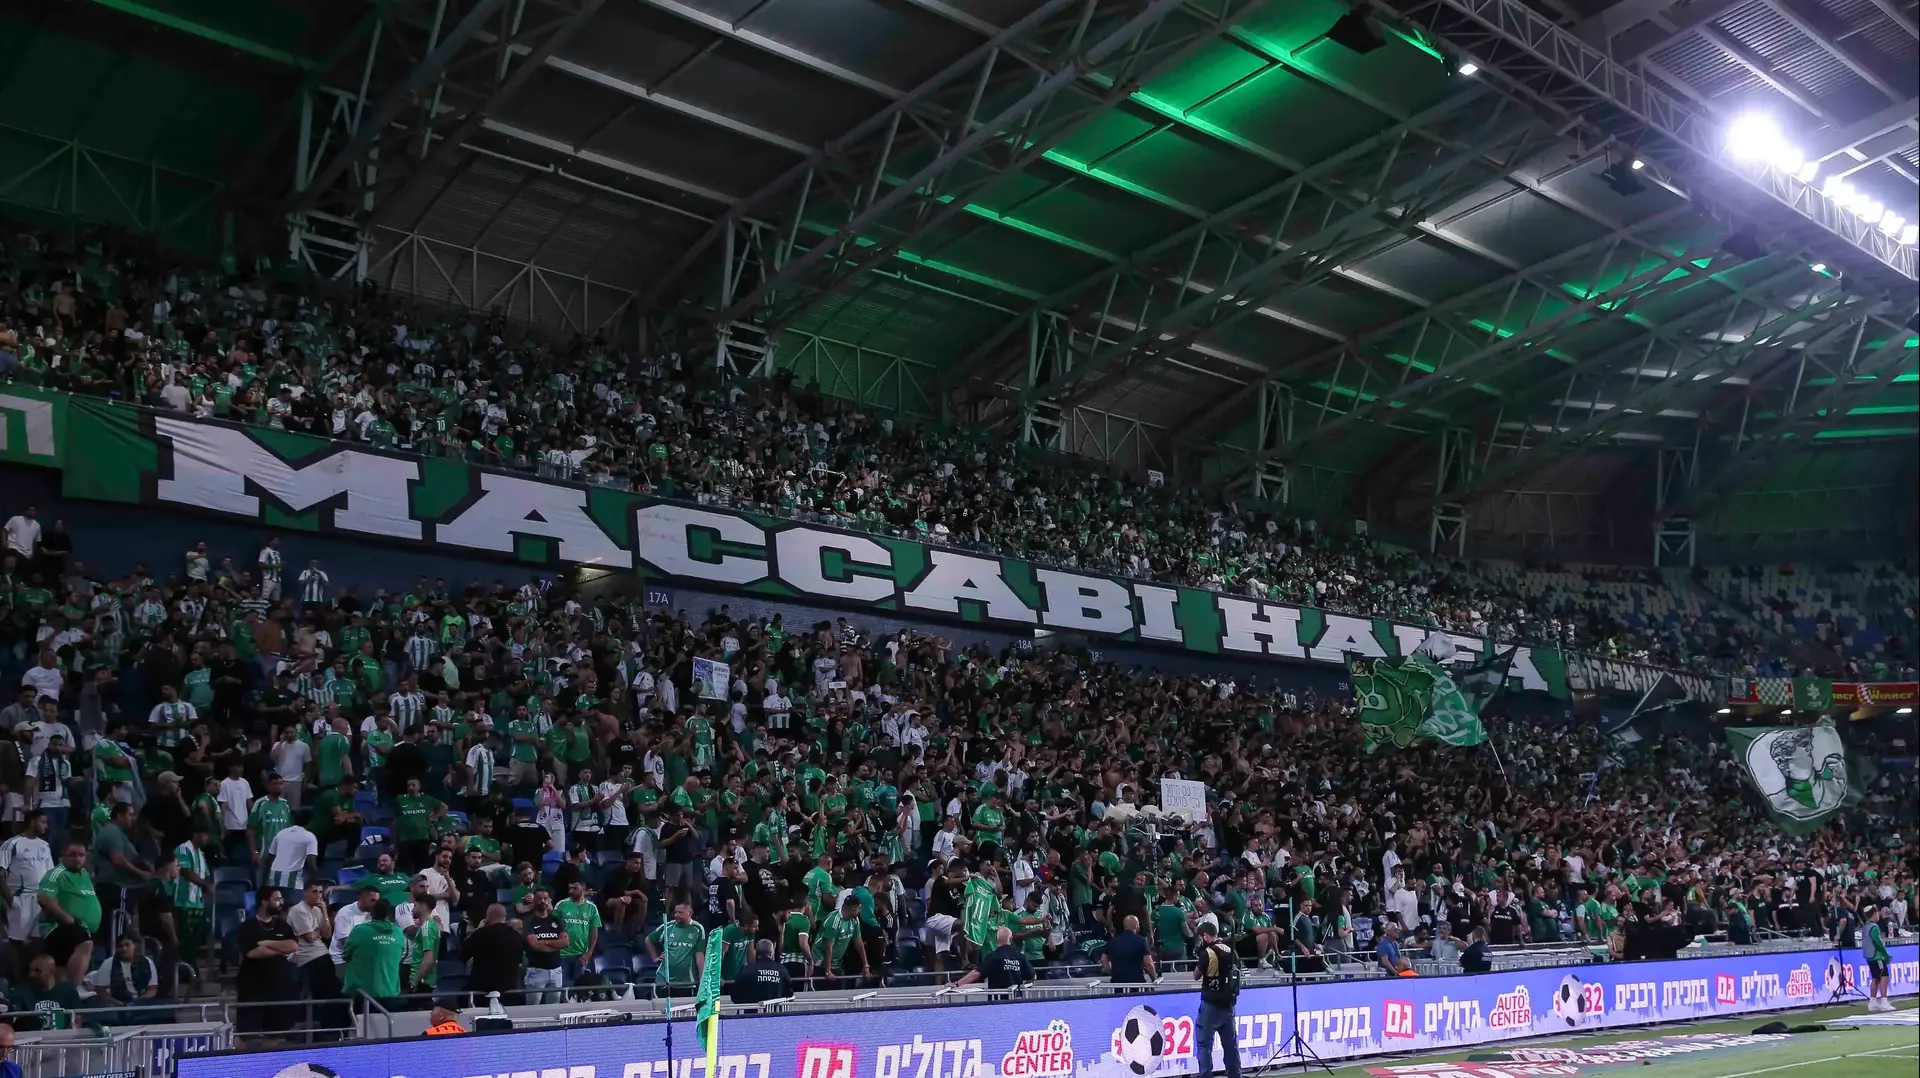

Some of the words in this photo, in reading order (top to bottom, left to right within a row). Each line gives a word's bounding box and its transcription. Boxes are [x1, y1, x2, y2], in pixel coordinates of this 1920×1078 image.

[437, 420, 445, 431] 10
[156, 416, 1184, 642] MACCABI
[648, 592, 669, 604] 17A
[1018, 640, 1032, 650] 18A
[1868, 688, 1914, 701] Winner
[402, 808, 426, 816] VOLVO
[564, 918, 589, 926] VOLVO
[757, 969, 779, 977] מטאור
[757, 975, 780, 983] אבטחה
[1791, 972, 1809, 983] AUTO
[1890, 962, 1918, 985] מכירת
[1615, 982, 1657, 1010] רכבים
[1662, 978, 1709, 1008] במכירת
[1717, 976, 1735, 1002] גם
[1741, 970, 1780, 1000] גדולים
[1787, 982, 1812, 995] CENTER
[35, 1000, 60, 1011] ADIDAS
[1497, 994, 1525, 1009] AUTO
[1298, 1006, 1371, 1041] במכירת
[1387, 1003, 1413, 1035] גם
[1424, 996, 1481, 1032] גדולים
[1490, 1009, 1530, 1027] CENTER
[1212, 1013, 1282, 1049] רכב
[1016, 1032, 1064, 1054] AUTO
[801, 1047, 852, 1078] גם
[875, 1034, 982, 1078] גדולים
[1003, 1051, 1072, 1076] CENTER
